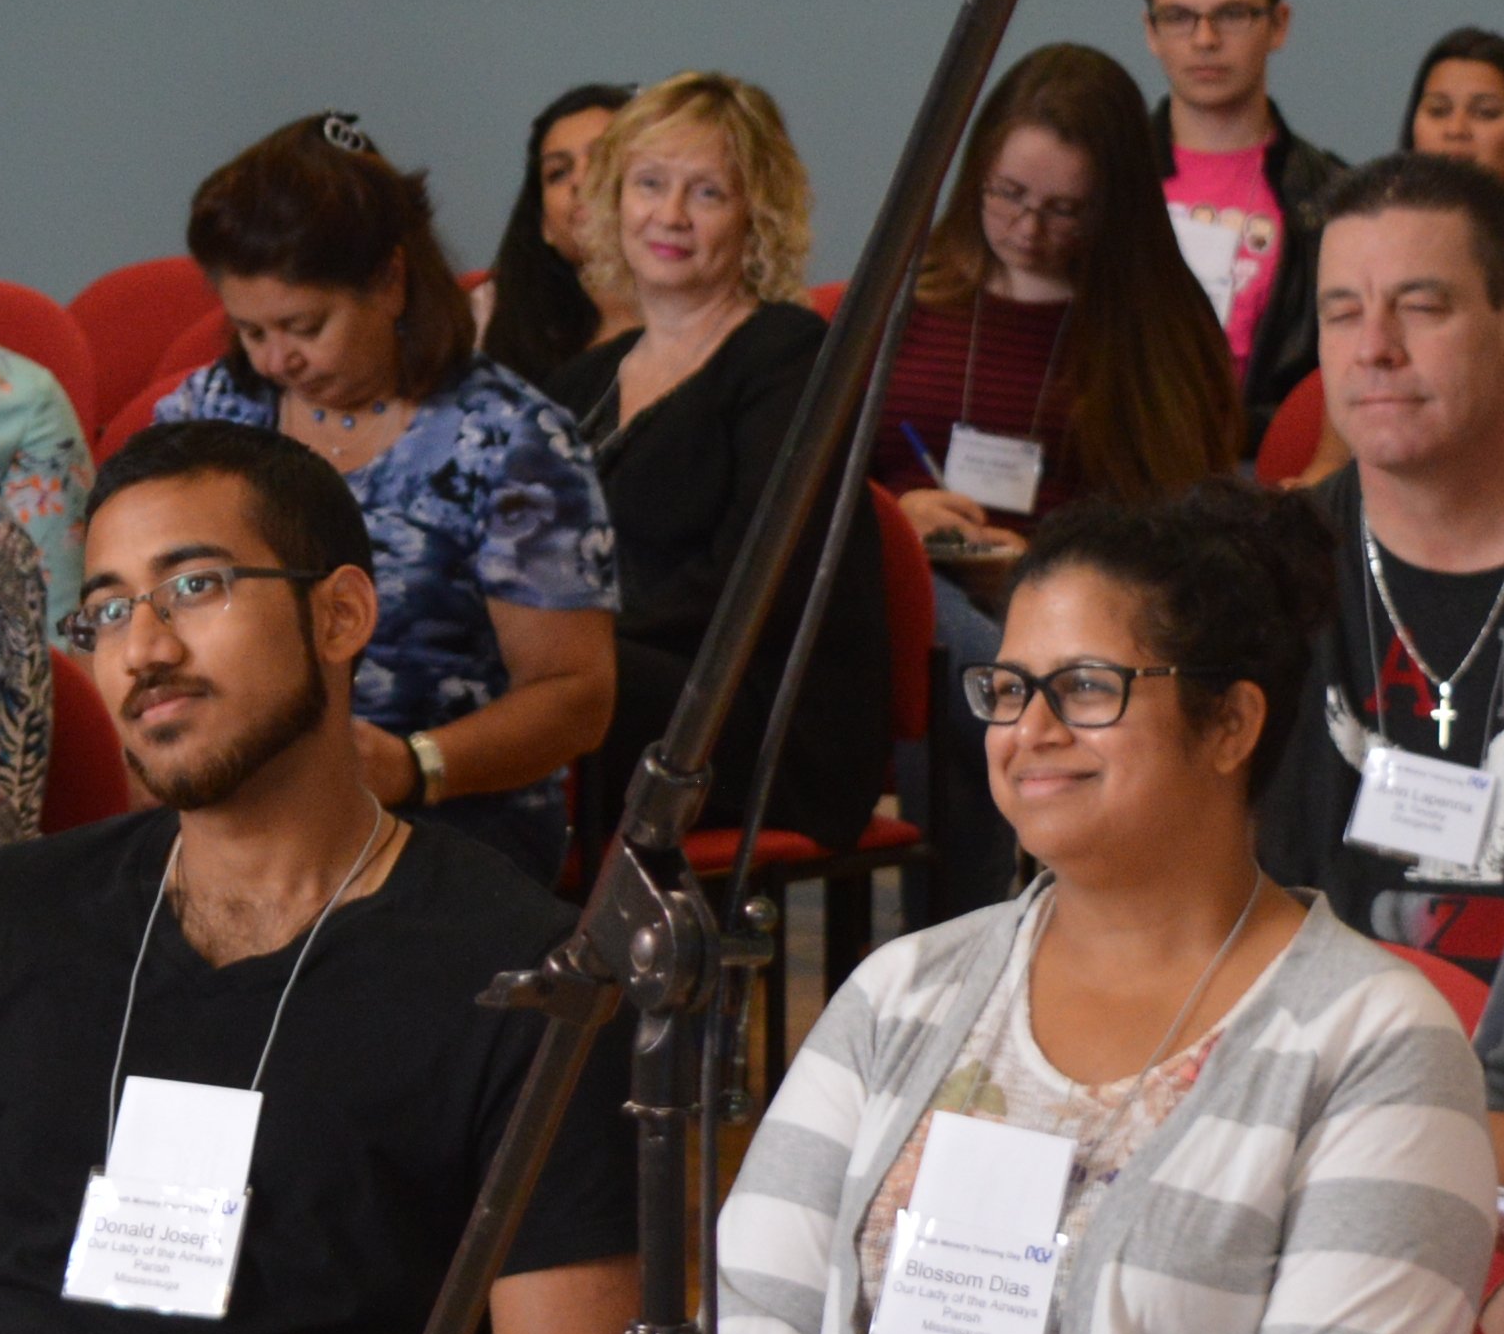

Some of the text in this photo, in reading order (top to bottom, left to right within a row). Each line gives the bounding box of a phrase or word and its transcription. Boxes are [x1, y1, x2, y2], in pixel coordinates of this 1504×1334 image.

[94, 1216, 155, 1239] Donald
[111, 1240, 139, 1257] Lady
[143, 1243, 156, 1256] of
[158, 1246, 176, 1259] the
[133, 1258, 170, 1275] Parish
[905, 1259, 1030, 1298] Blossom Dias
[893, 1279, 1038, 1319] Our Lady of the Airways
[942, 1305, 982, 1324] Parish
